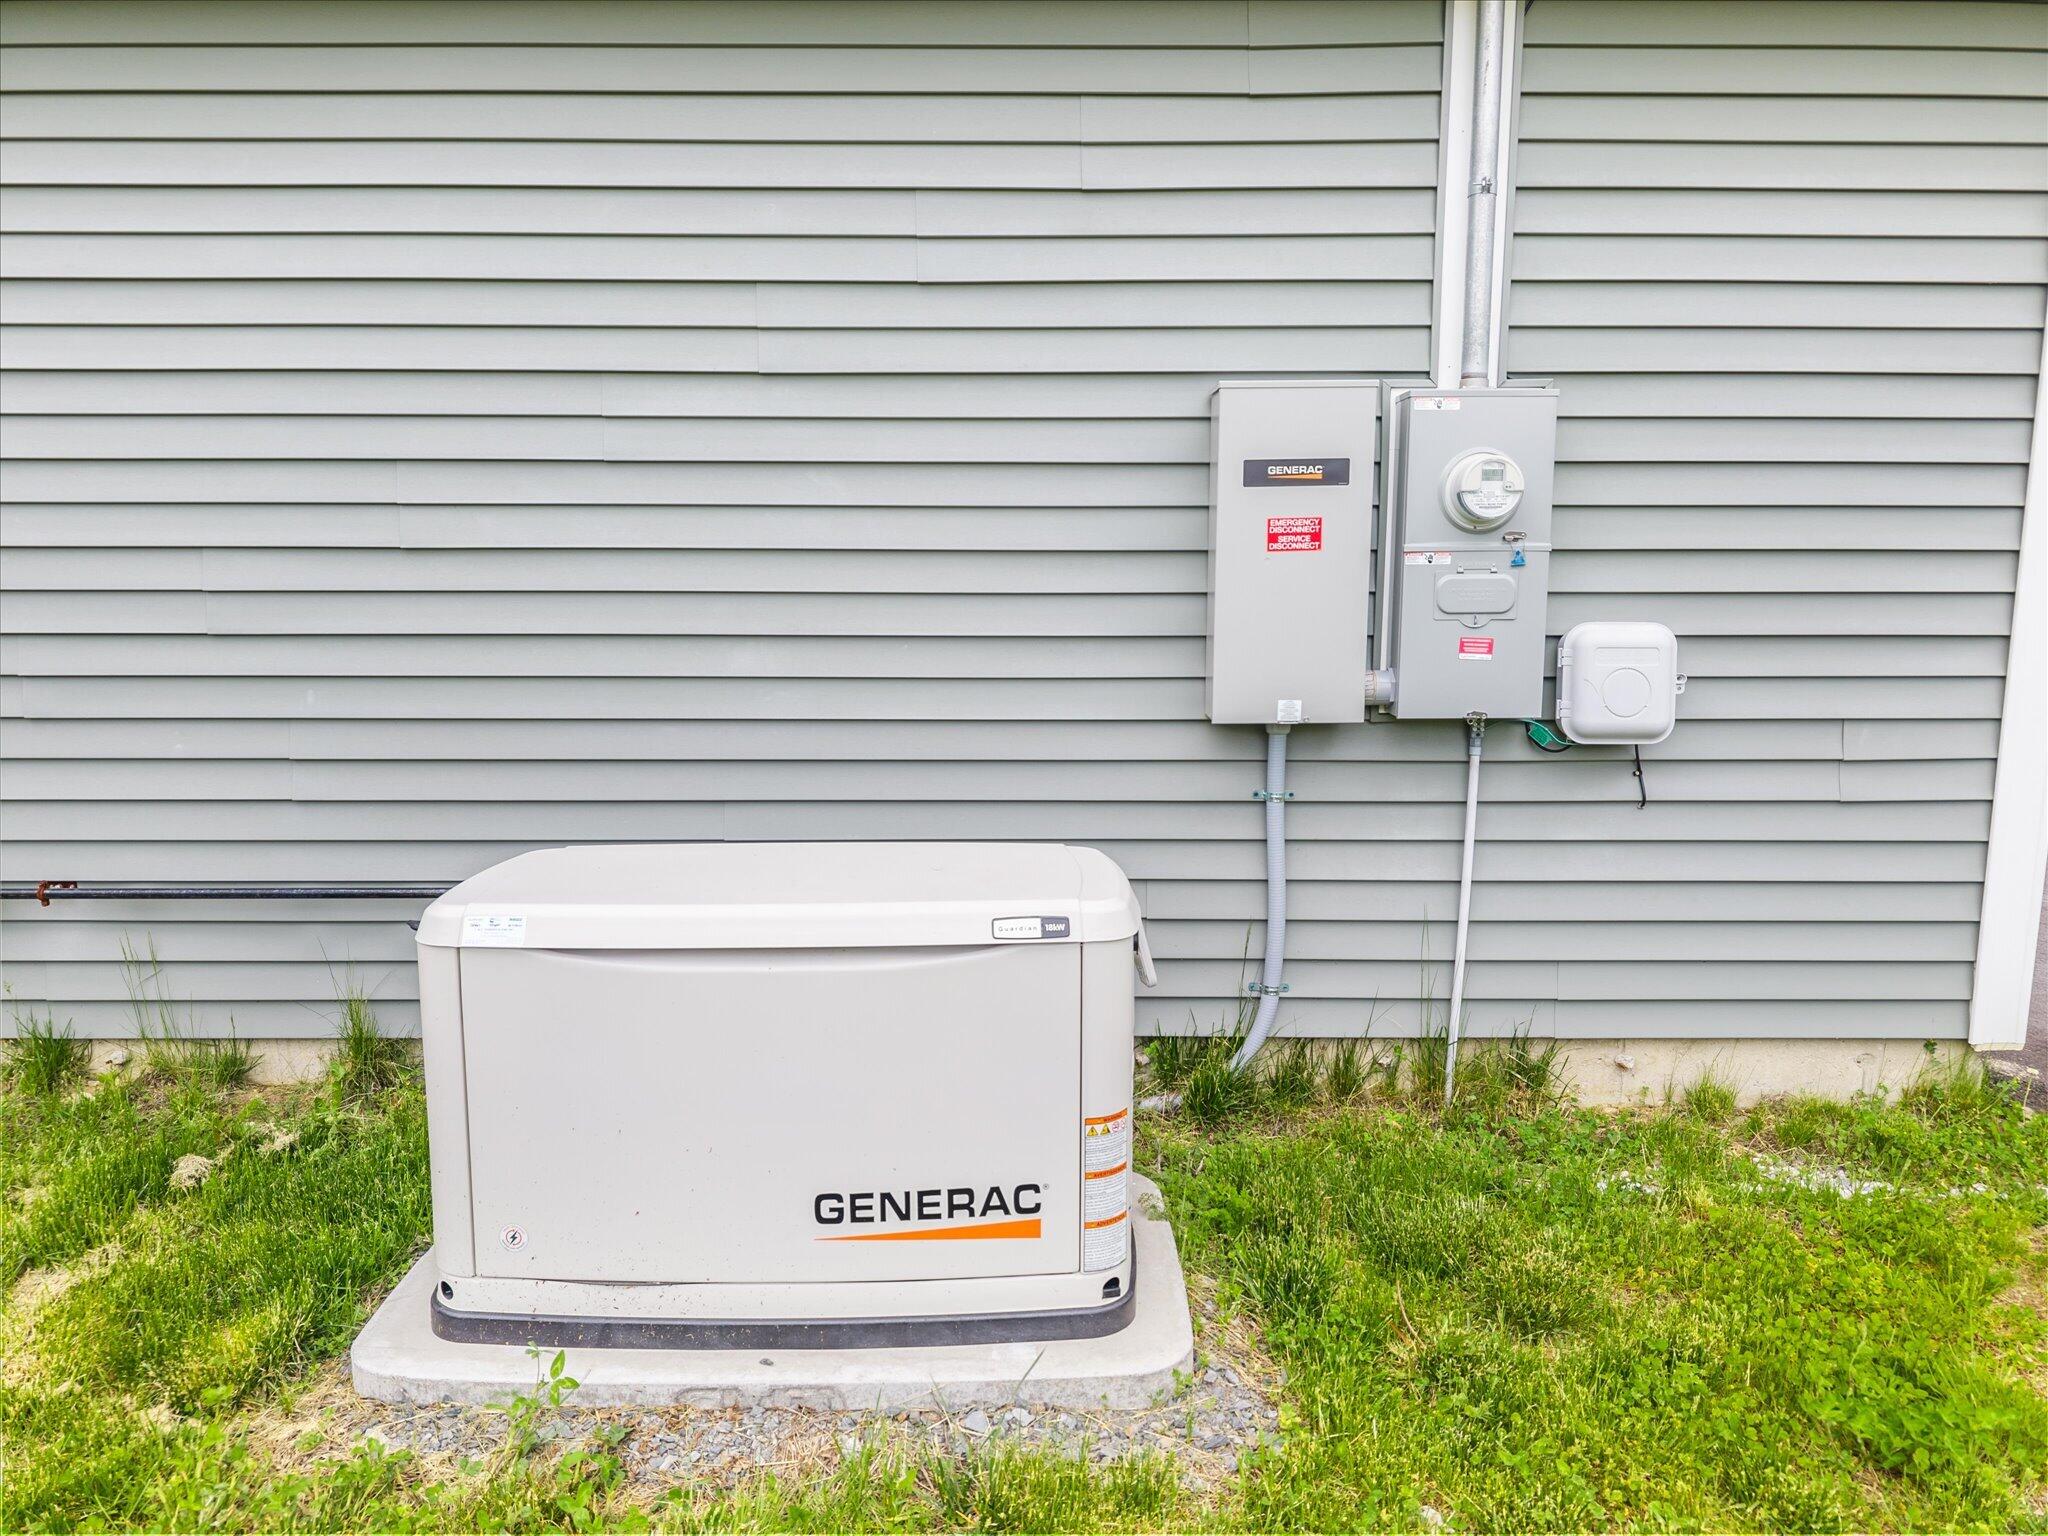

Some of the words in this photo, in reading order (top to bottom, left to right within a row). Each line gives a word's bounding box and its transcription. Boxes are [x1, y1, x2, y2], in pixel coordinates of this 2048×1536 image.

[1268, 465, 1323, 474] GENERAC
[1278, 535, 1311, 543] SERVICE
[1269, 542, 1320, 550] DISCONNECT
[1045, 923, 1065, 931] 18kW
[814, 1183, 1042, 1225] GENERAC
